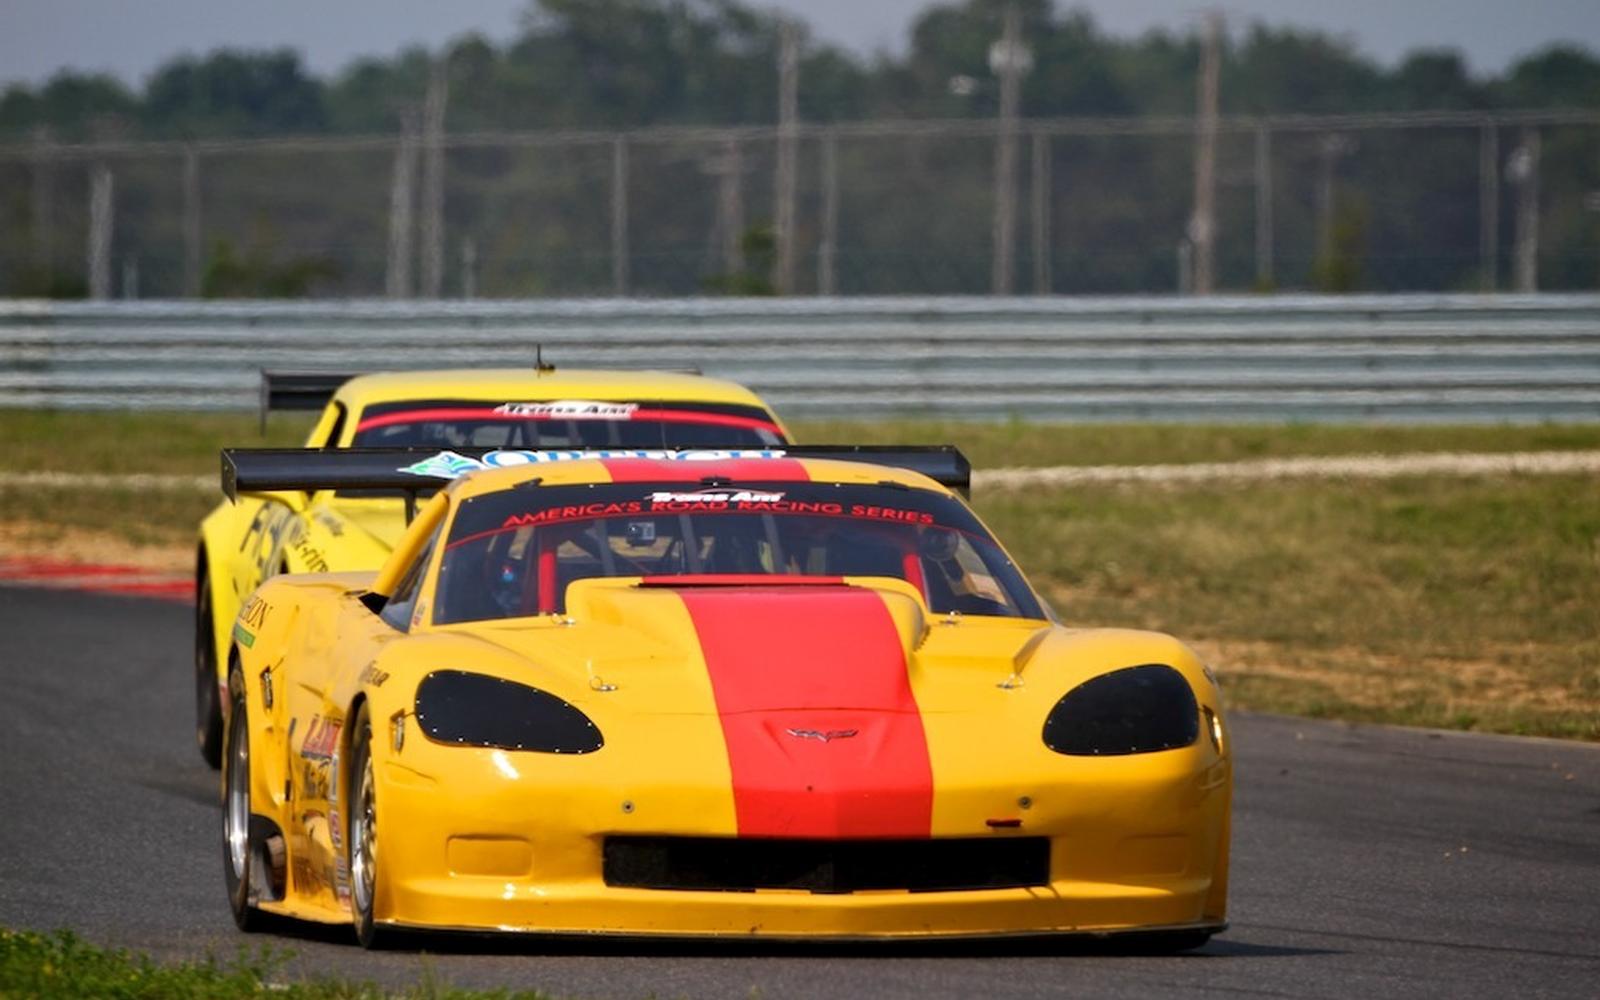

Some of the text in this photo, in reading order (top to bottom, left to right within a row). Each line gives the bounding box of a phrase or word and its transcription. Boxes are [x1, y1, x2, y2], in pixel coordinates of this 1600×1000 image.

[650, 491, 729, 503] Trans
[503, 500, 934, 528] AMERICA'S ROAD RACING SERIES
